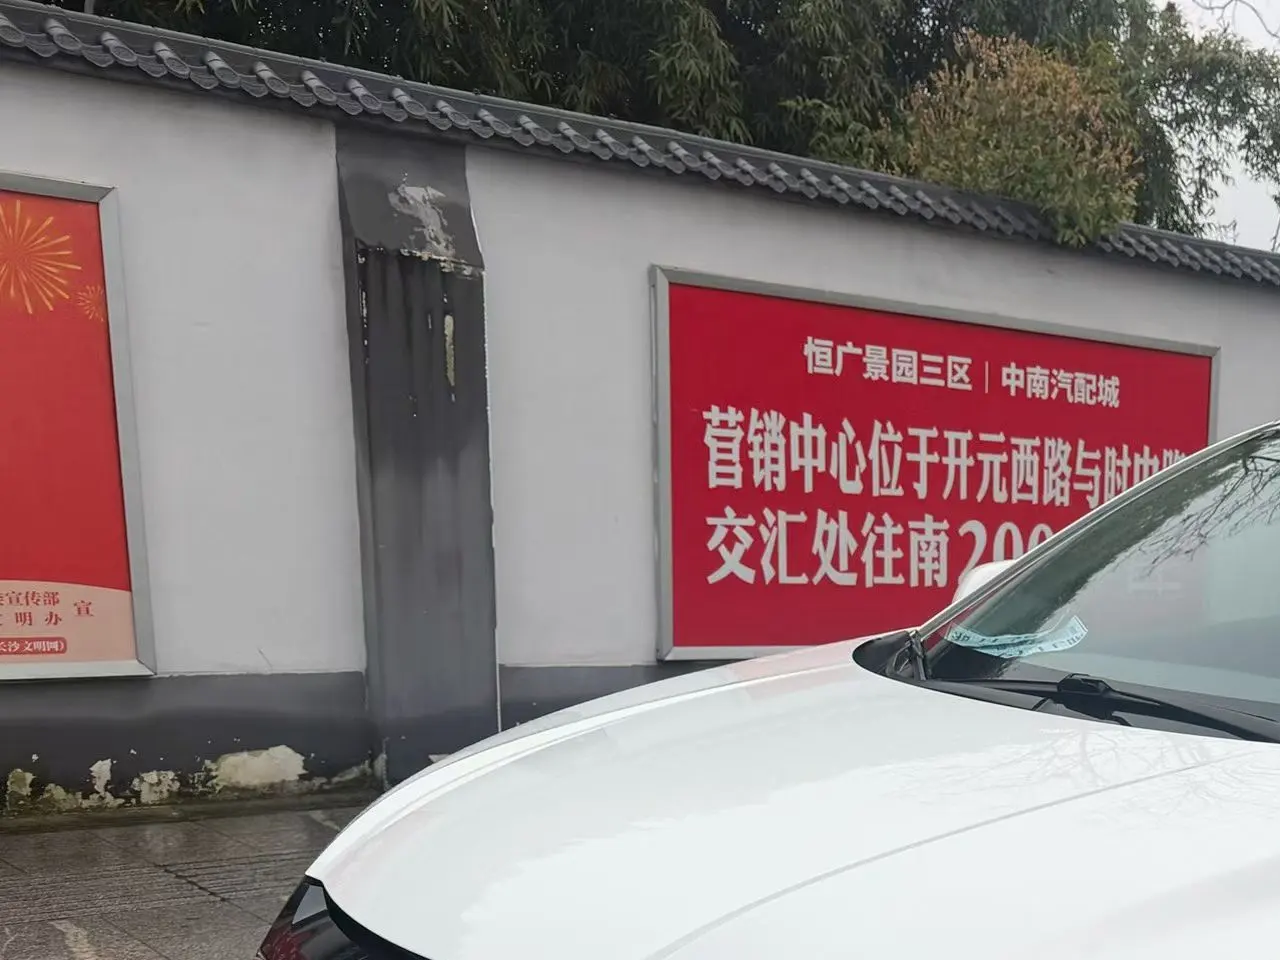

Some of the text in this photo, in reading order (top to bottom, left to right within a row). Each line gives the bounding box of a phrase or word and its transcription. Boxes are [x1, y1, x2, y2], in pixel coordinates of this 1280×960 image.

[802, 336, 1121, 408] 恒广景园三区 中南汽配城
[702, 405, 1185, 509] 营销中心位于开元西路与时
[706, 505, 1053, 588] 交汇处往南20
[0, 611, 62, 626] 明办
[73, 600, 94, 616] 宣
